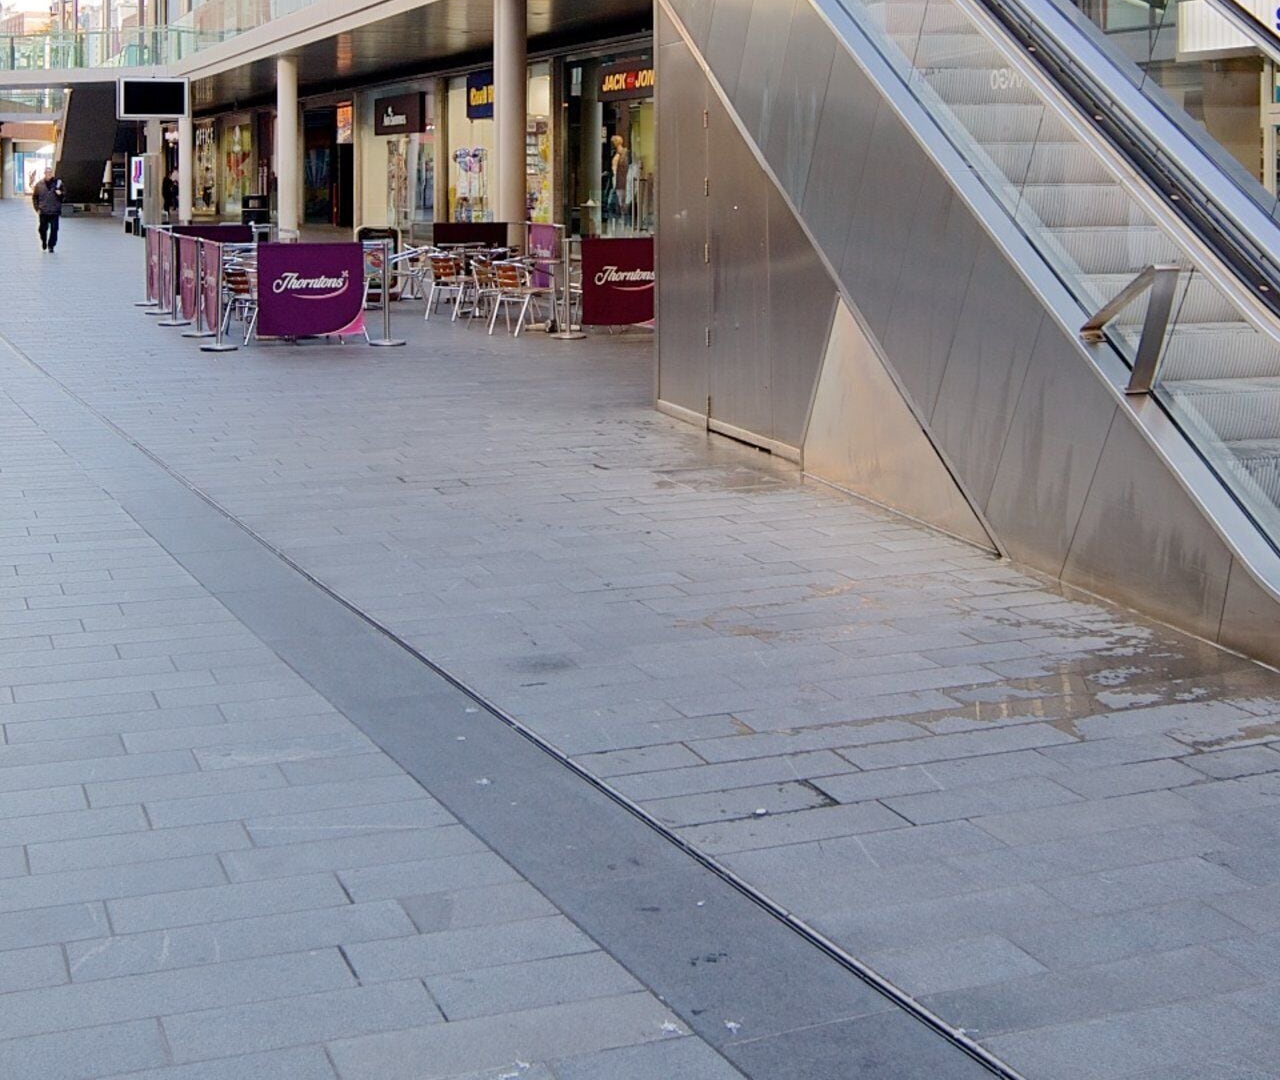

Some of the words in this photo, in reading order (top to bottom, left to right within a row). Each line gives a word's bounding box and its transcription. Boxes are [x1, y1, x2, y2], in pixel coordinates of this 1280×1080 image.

[602, 72, 626, 91] JACK
[635, 69, 655, 88] JON
[273, 271, 345, 294] Thorntons
[595, 266, 655, 286] Thorntons
